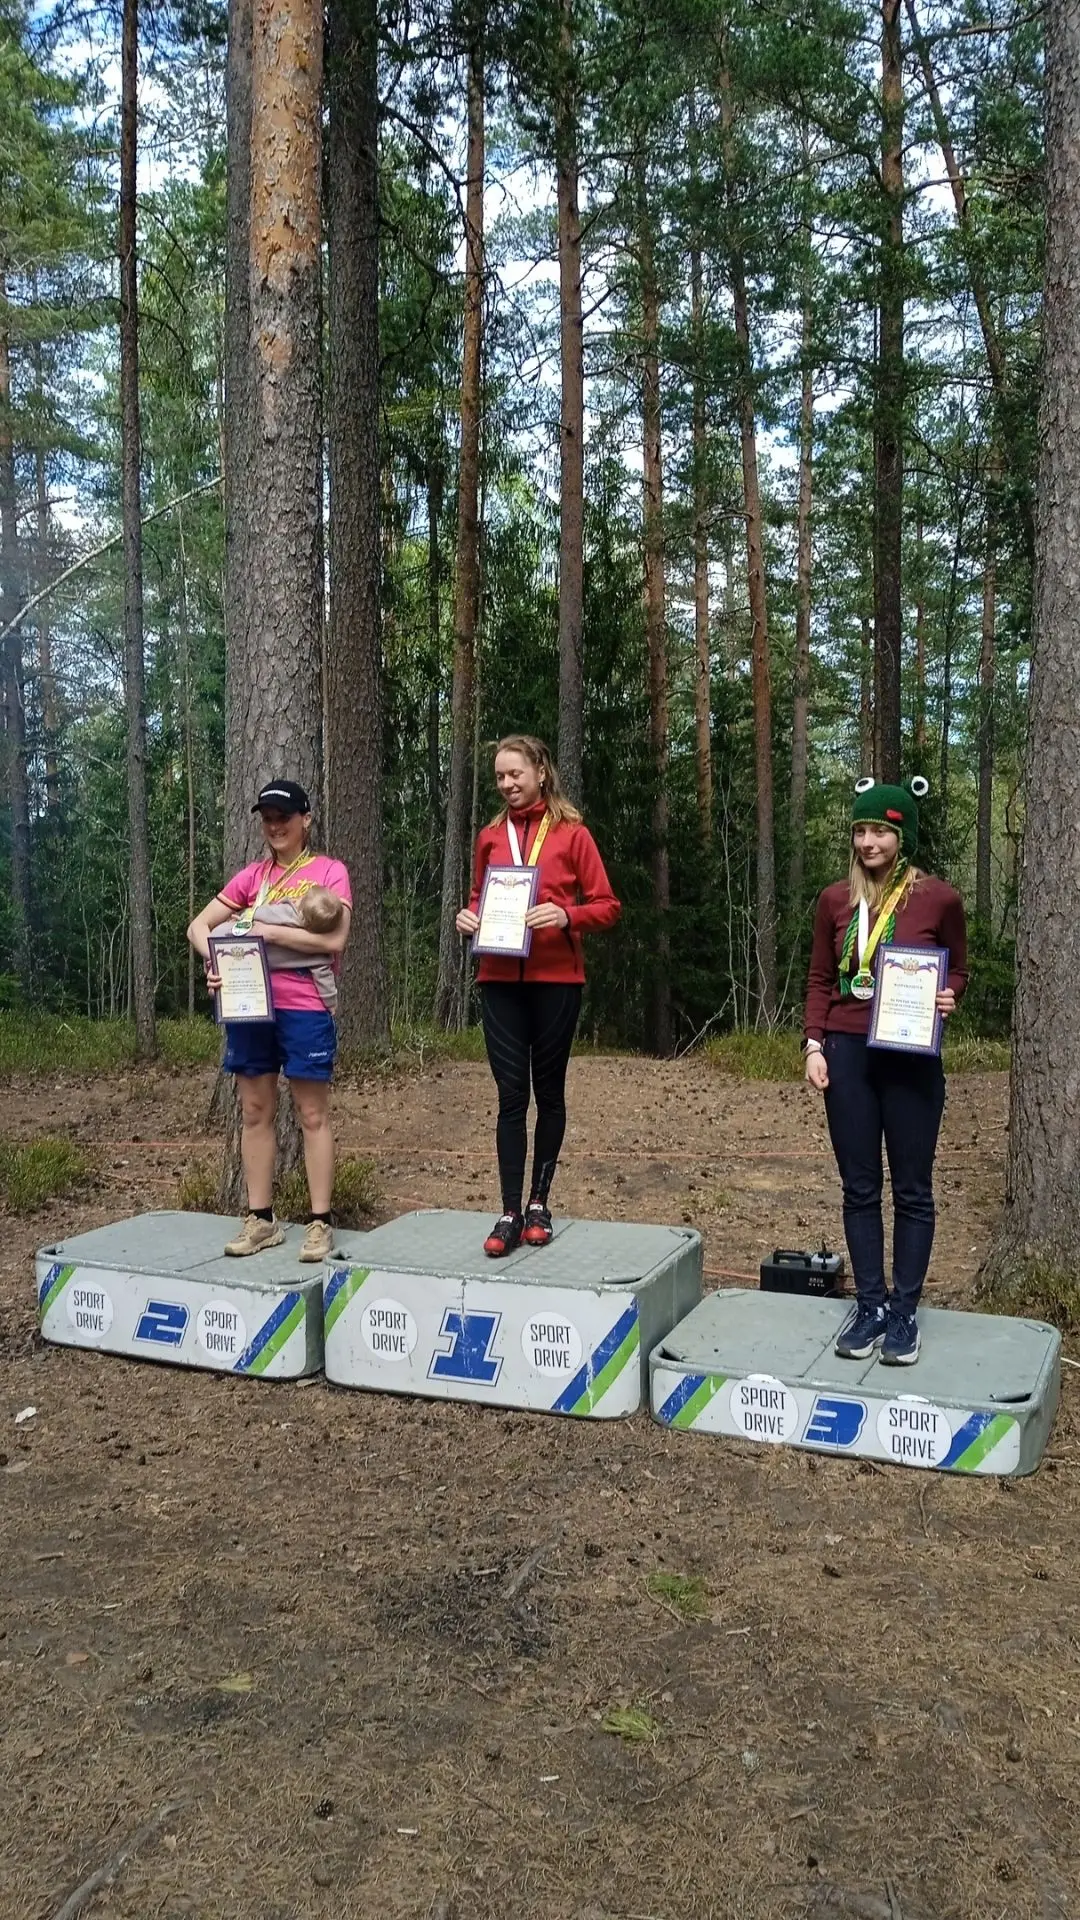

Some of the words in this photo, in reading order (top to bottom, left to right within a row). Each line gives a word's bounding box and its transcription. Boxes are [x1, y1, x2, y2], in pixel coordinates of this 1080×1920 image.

[73, 1290, 105, 1310] SPORT
[75, 1311, 104, 1332] DRIVE
[133, 1298, 191, 1348] 2
[204, 1309, 238, 1331] SPORT
[369, 1309, 408, 1330] SPORT
[206, 1332, 236, 1354] DRIVE
[372, 1332, 406, 1354] DRIVE
[530, 1323, 572, 1345] SPORT
[427, 1307, 504, 1387] 1
[534, 1348, 571, 1369] DRIVE
[740, 1386, 787, 1410] SPORT
[744, 1412, 785, 1436] DRIVE
[801, 1392, 868, 1449] 3
[889, 1408, 939, 1433] SPORT
[892, 1435, 936, 1460] DRIVE
